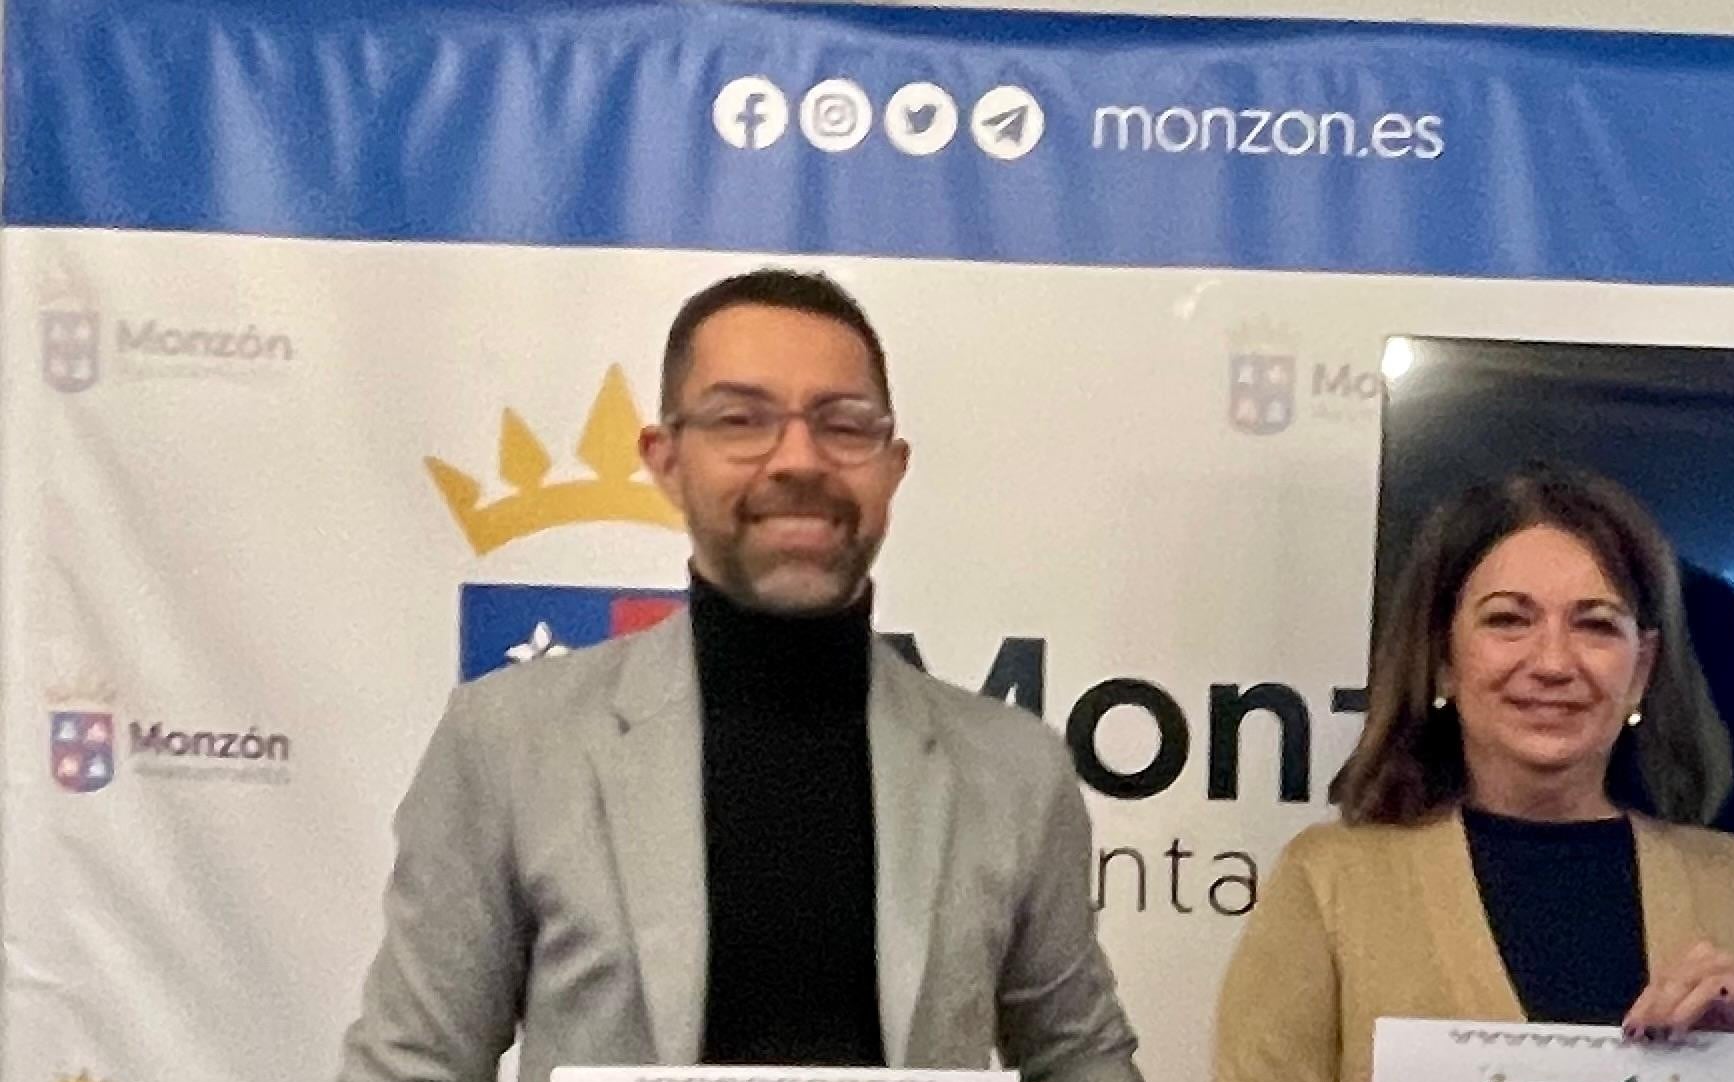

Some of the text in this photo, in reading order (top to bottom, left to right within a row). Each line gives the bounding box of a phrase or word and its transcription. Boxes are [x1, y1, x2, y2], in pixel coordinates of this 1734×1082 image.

[1092, 105, 1446, 159] monzon.es
[115, 318, 294, 361] Monzón
[129, 720, 290, 761] Monzón
